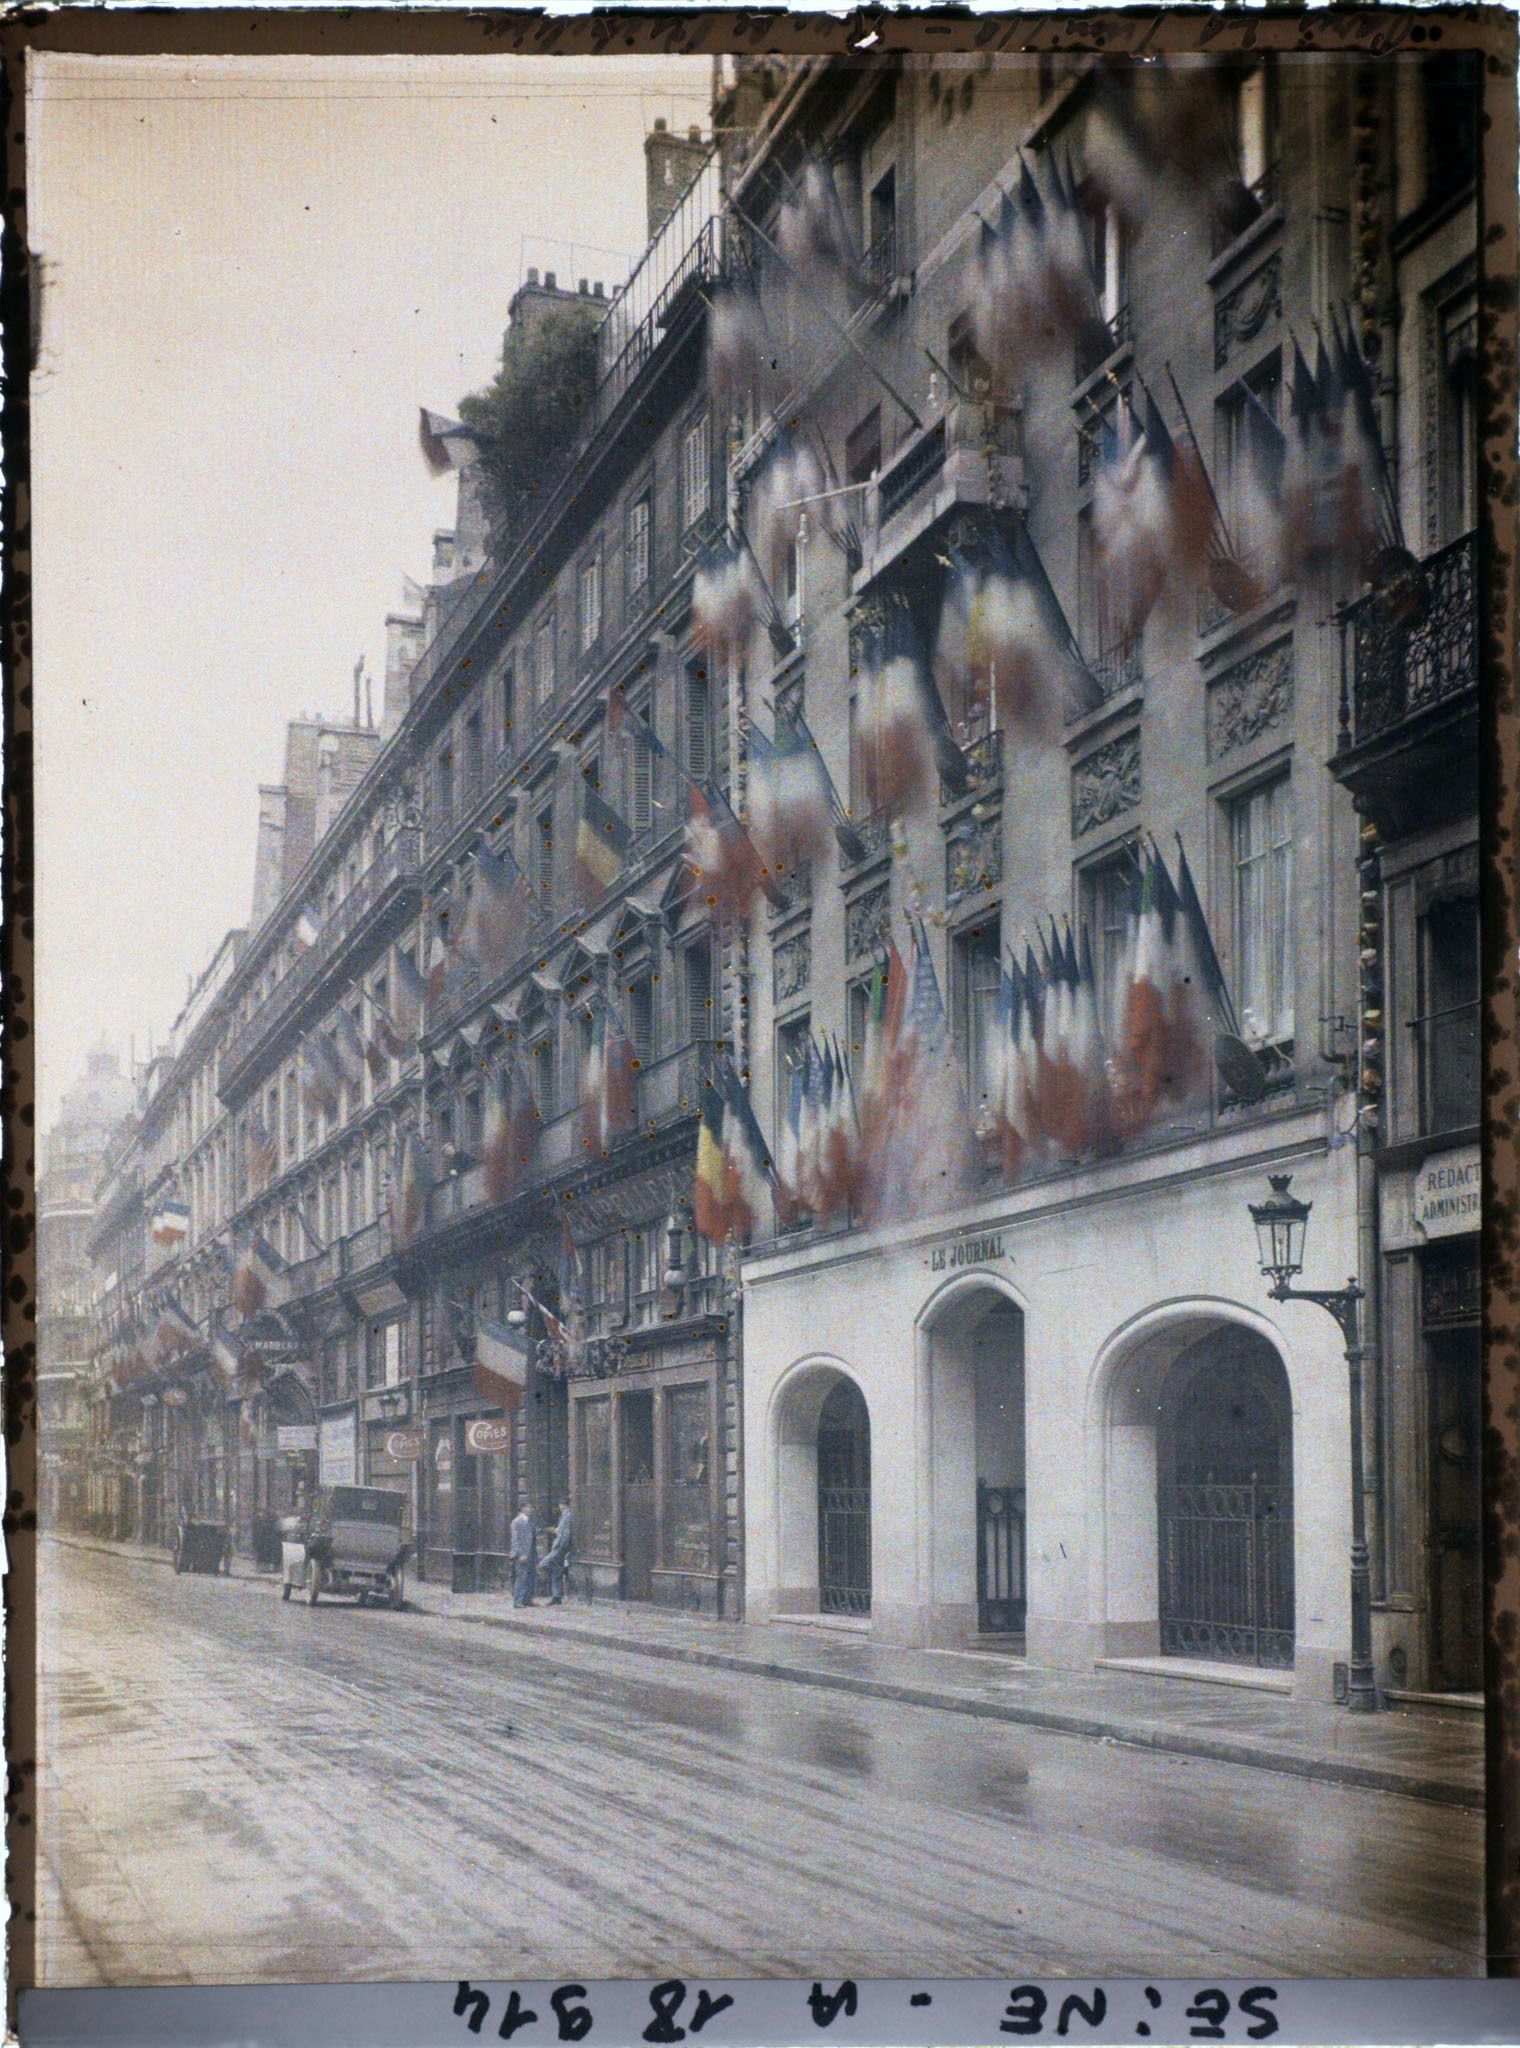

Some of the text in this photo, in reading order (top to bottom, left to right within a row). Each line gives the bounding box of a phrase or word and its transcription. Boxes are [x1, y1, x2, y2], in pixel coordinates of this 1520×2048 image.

[932, 1235, 1005, 1272] LE JOURNAL
[807, 1981, 858, 2028] A
